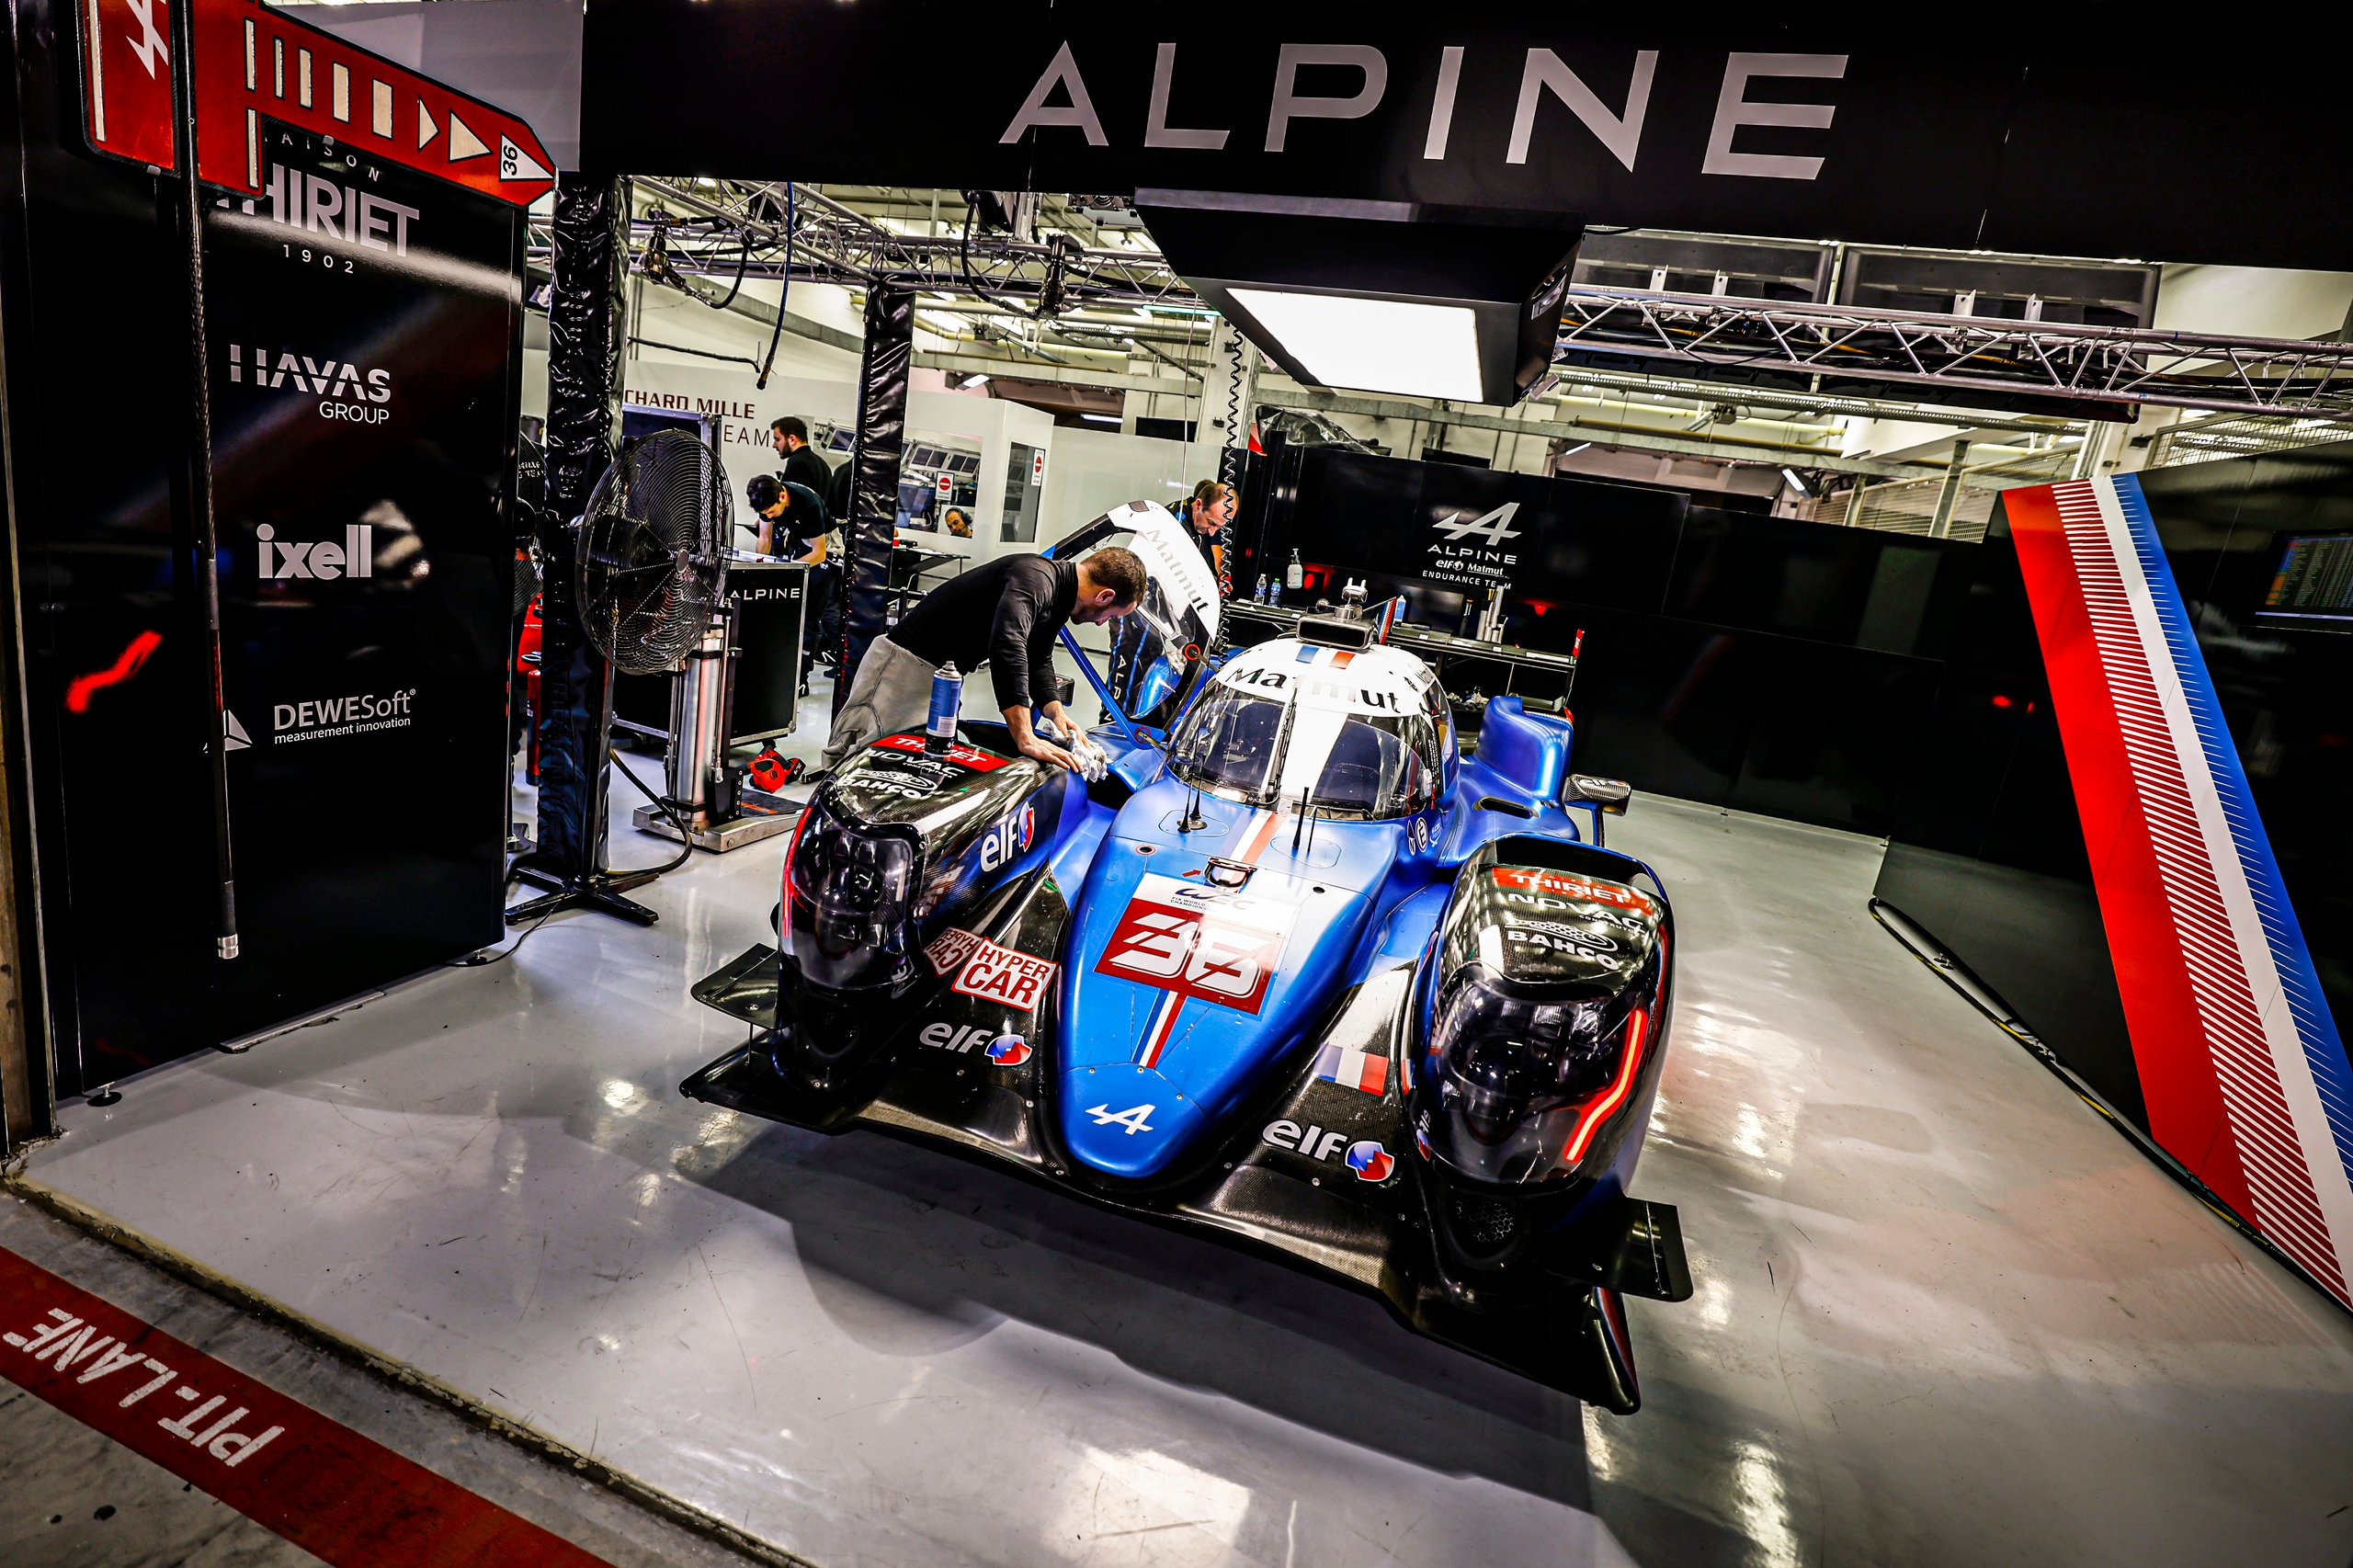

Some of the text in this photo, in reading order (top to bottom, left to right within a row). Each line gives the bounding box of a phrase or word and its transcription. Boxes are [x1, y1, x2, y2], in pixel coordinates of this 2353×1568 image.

[998, 40, 1849, 180] ALPINE
[265, 133, 379, 182] AISON
[503, 145, 517, 176] 36
[216, 163, 419, 257] HIRIET
[283, 244, 354, 274] 1902
[231, 344, 391, 403] HAVAS
[320, 401, 390, 425] GROUP
[697, 399, 755, 419] MILLE
[256, 523, 371, 580] ixell
[1427, 544, 1517, 564] ALPINE
[1436, 560, 1504, 575] elf Matmut
[731, 588, 800, 600] ALPINE
[1422, 570, 1511, 590] ENDURANCE TEM
[274, 718, 411, 744] measurement innovation
[868, 748, 965, 776] NOVAC
[837, 778, 922, 800] BAHCO
[981, 816, 1017, 872] elf
[1509, 874, 1632, 903] THIRIET
[1507, 893, 1645, 934] NOVAC
[977, 945, 1051, 981] HYPER
[1108, 913, 1270, 998] 36
[1507, 930, 1620, 971] BAHCO
[963, 963, 1039, 1004] CAR
[919, 1022, 994, 1053] elf
[1263, 1119, 1348, 1161] elf
[3, 1308, 285, 1467] PIT-LANE
